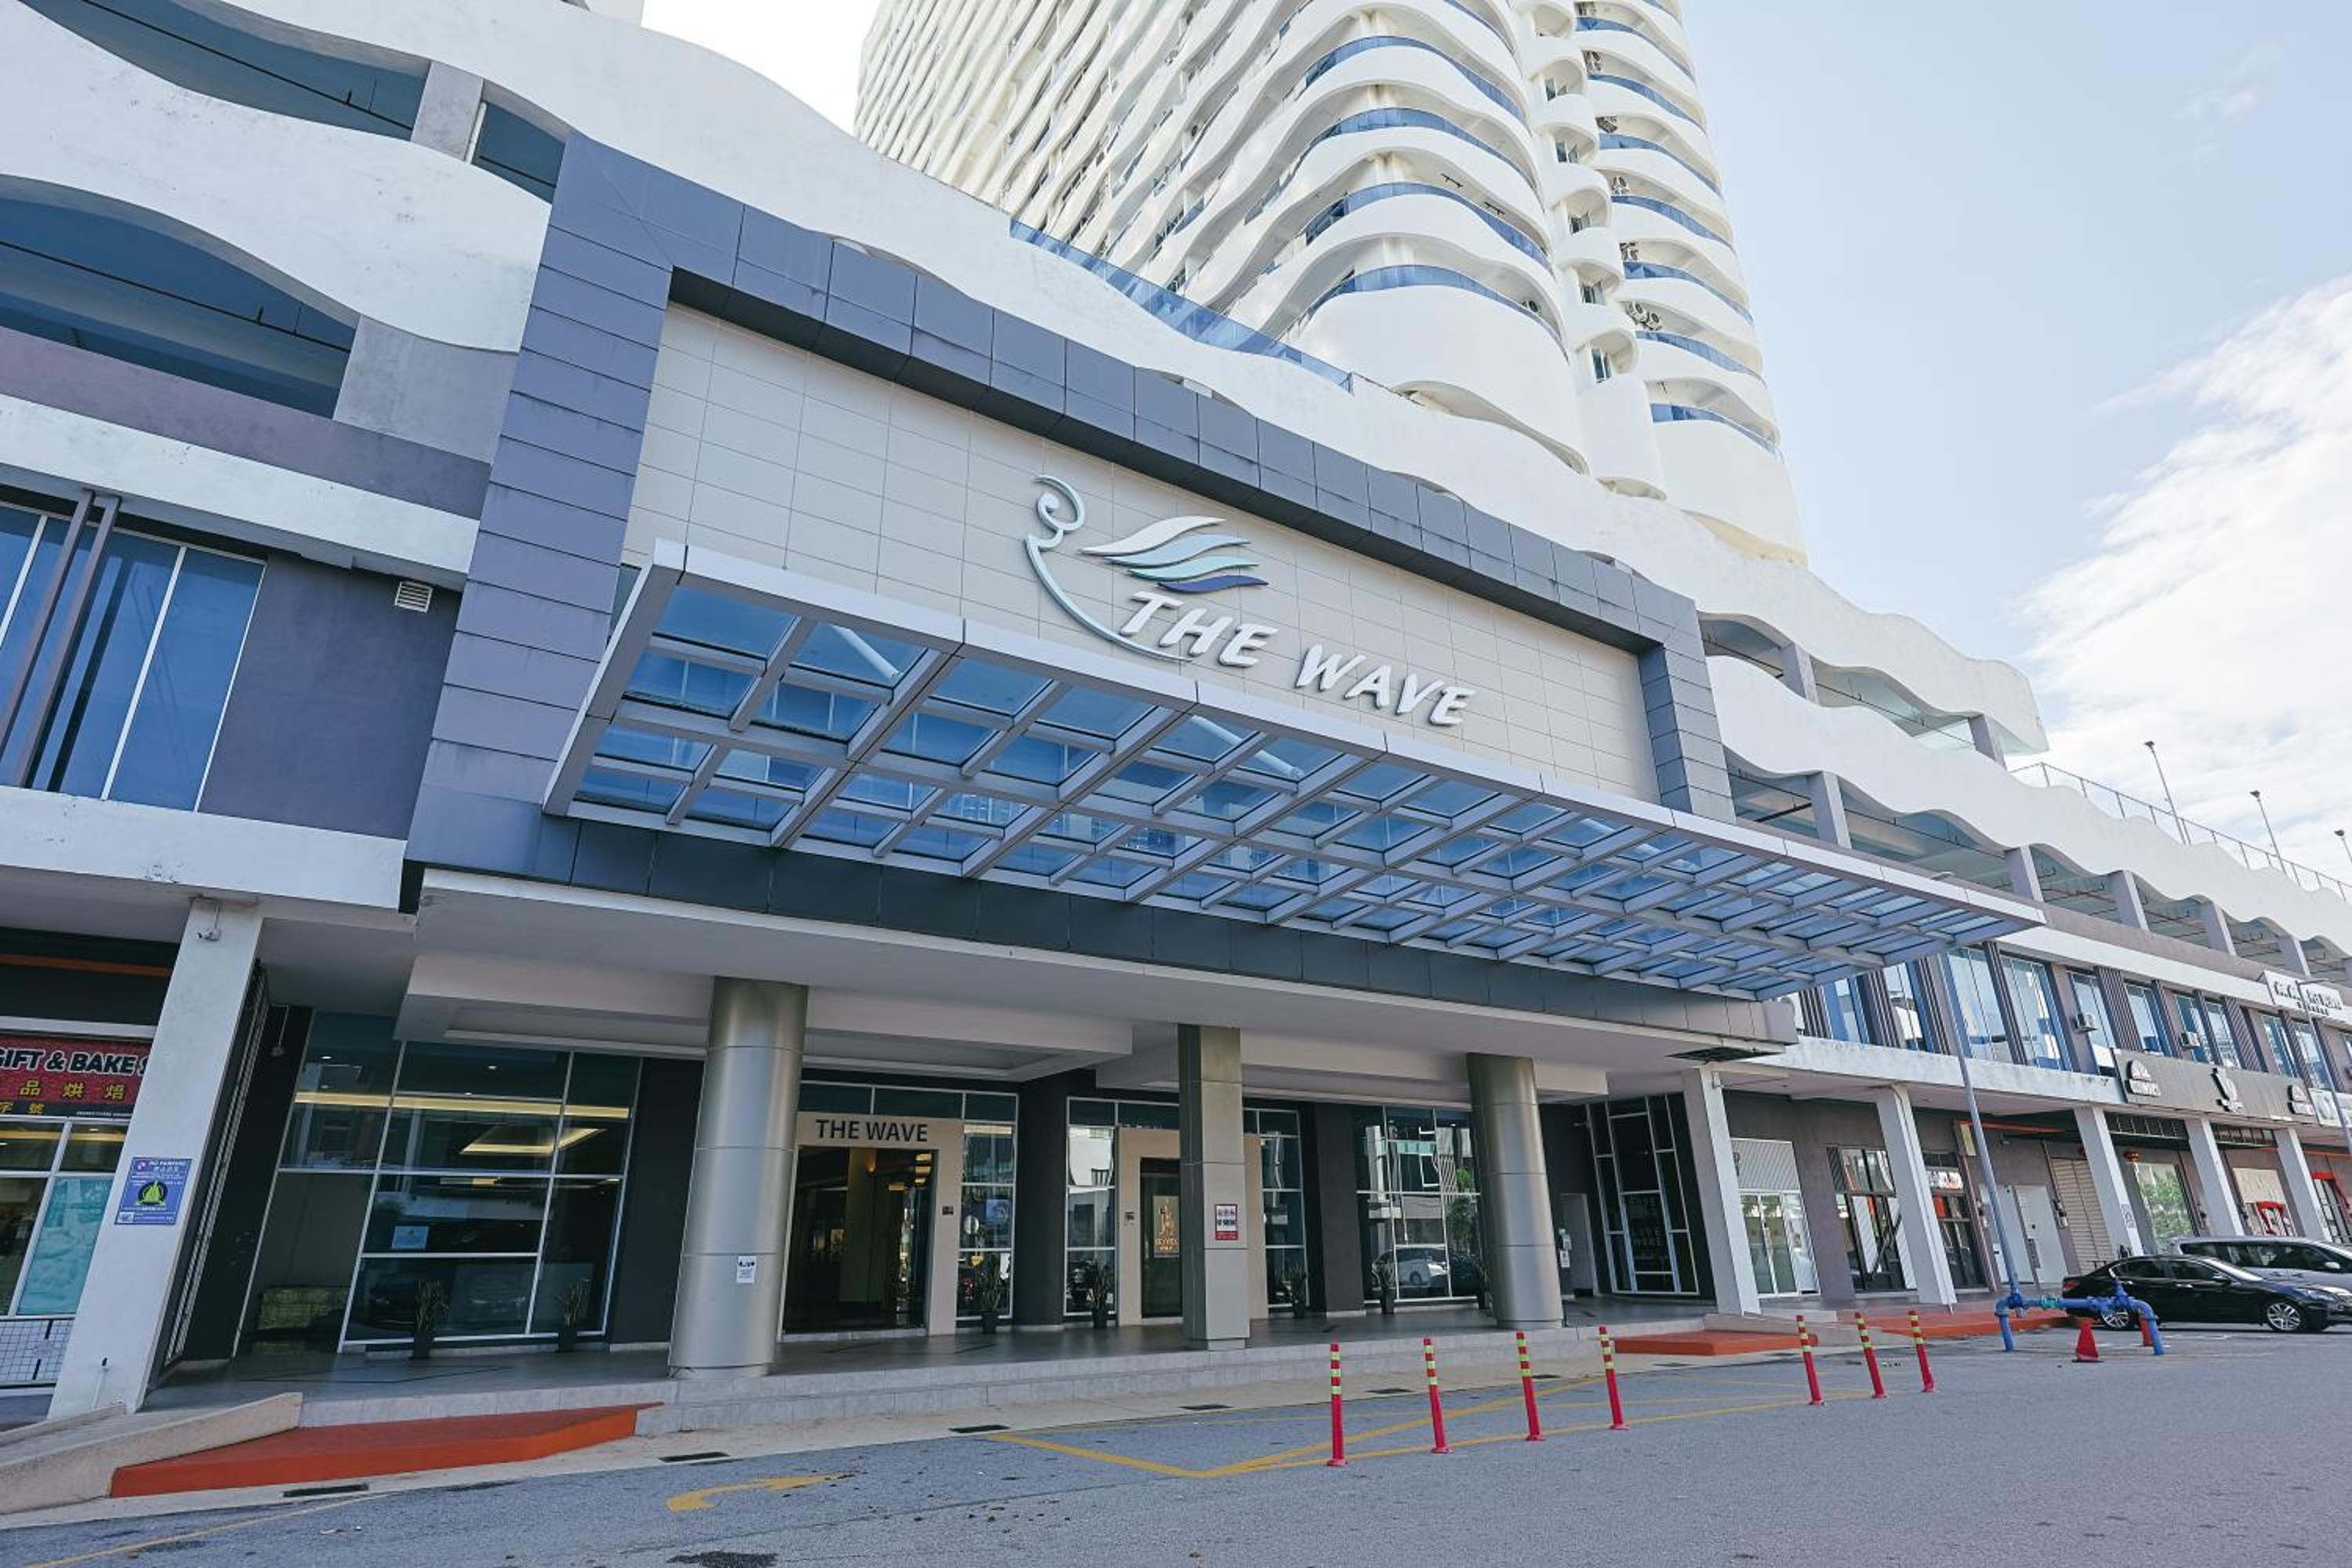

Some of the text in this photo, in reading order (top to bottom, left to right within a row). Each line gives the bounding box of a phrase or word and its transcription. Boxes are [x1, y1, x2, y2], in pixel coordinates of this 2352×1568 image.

[1120, 591, 1477, 726] THE WAVE
[45, 1050, 67, 1073] &
[67, 1051, 138, 1076] BAKE
[815, 1119, 927, 1142] THE WAVE
